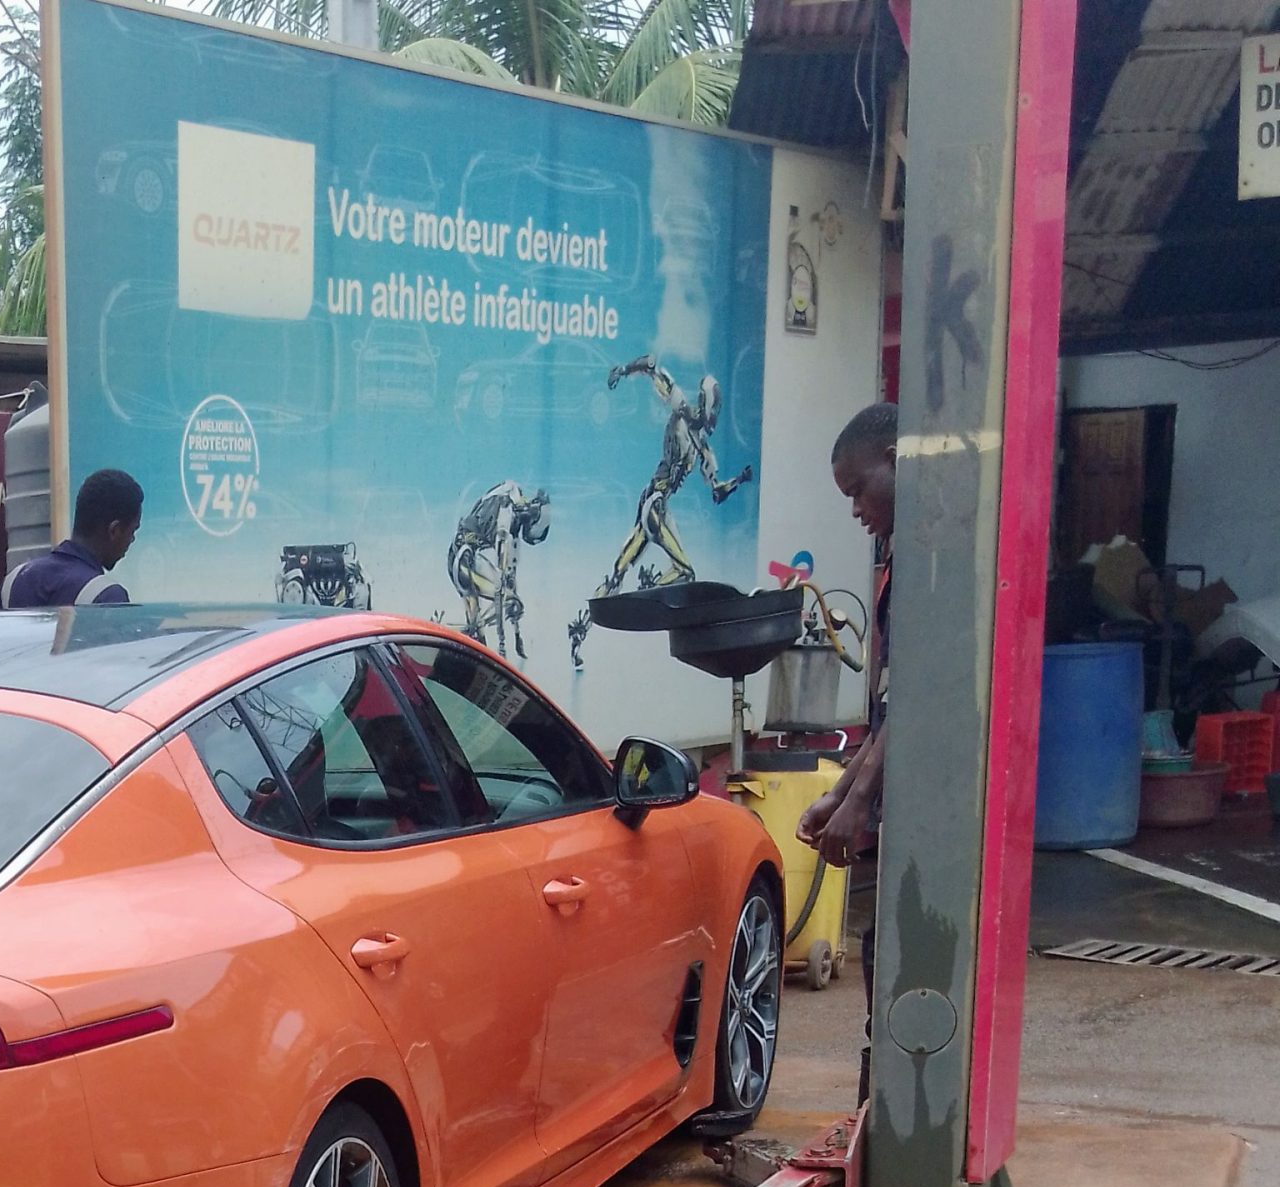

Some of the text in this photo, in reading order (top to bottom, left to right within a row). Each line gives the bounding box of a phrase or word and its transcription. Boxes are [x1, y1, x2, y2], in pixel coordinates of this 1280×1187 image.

[192, 212, 302, 255] QUARTZ
[327, 186, 609, 272] Votre moteur devient
[327, 271, 619, 344] un athlète infatiguable
[189, 434, 252, 452] PROTECTION
